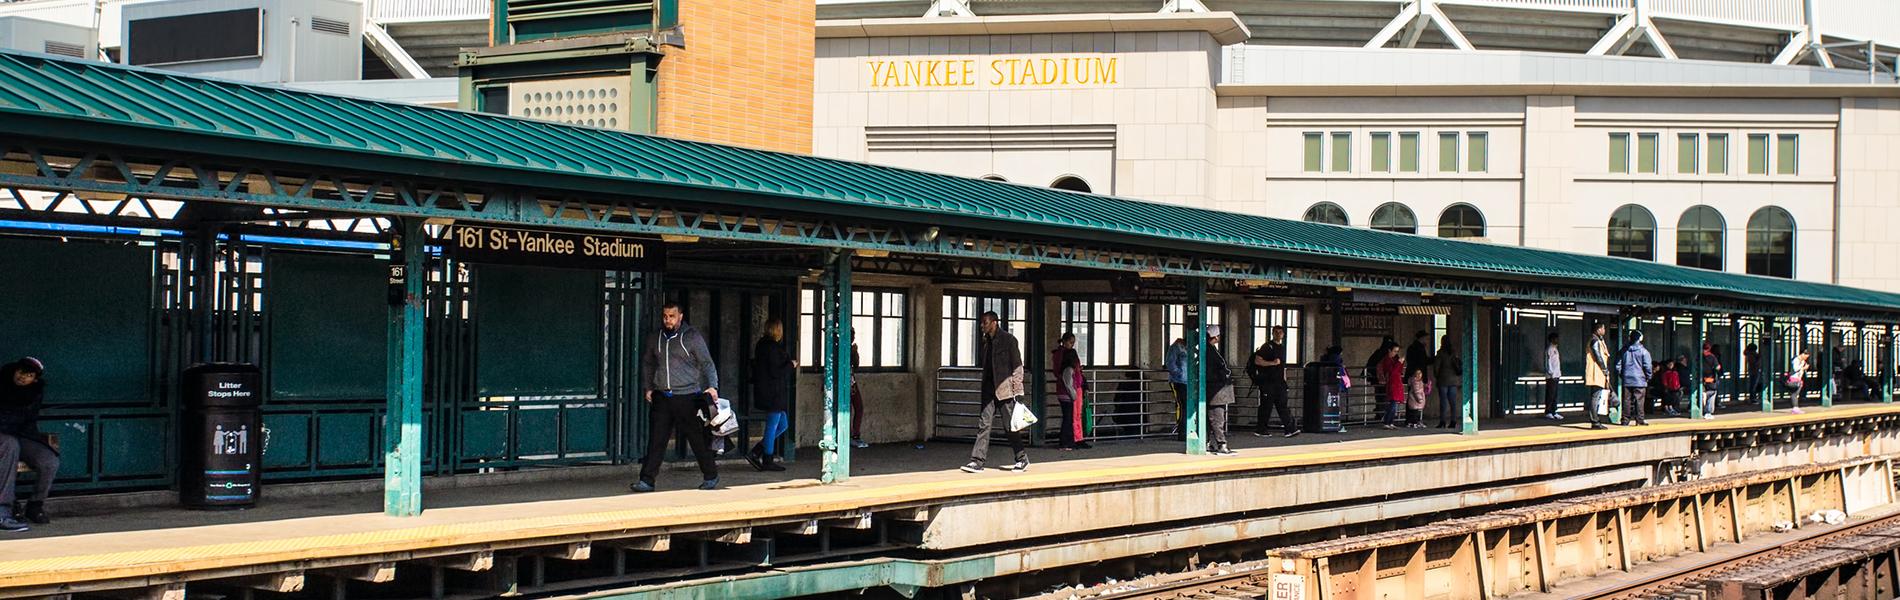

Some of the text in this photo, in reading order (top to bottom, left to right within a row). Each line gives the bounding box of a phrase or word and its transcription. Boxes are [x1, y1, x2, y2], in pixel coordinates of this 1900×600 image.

[866, 57, 1118, 87] YANKEE STADIUM
[456, 227, 644, 258] 161 St-Yankee Stadium
[391, 267, 403, 277] 161
[207, 390, 251, 398] Stops Here
[1276, 582, 1289, 600] ER
